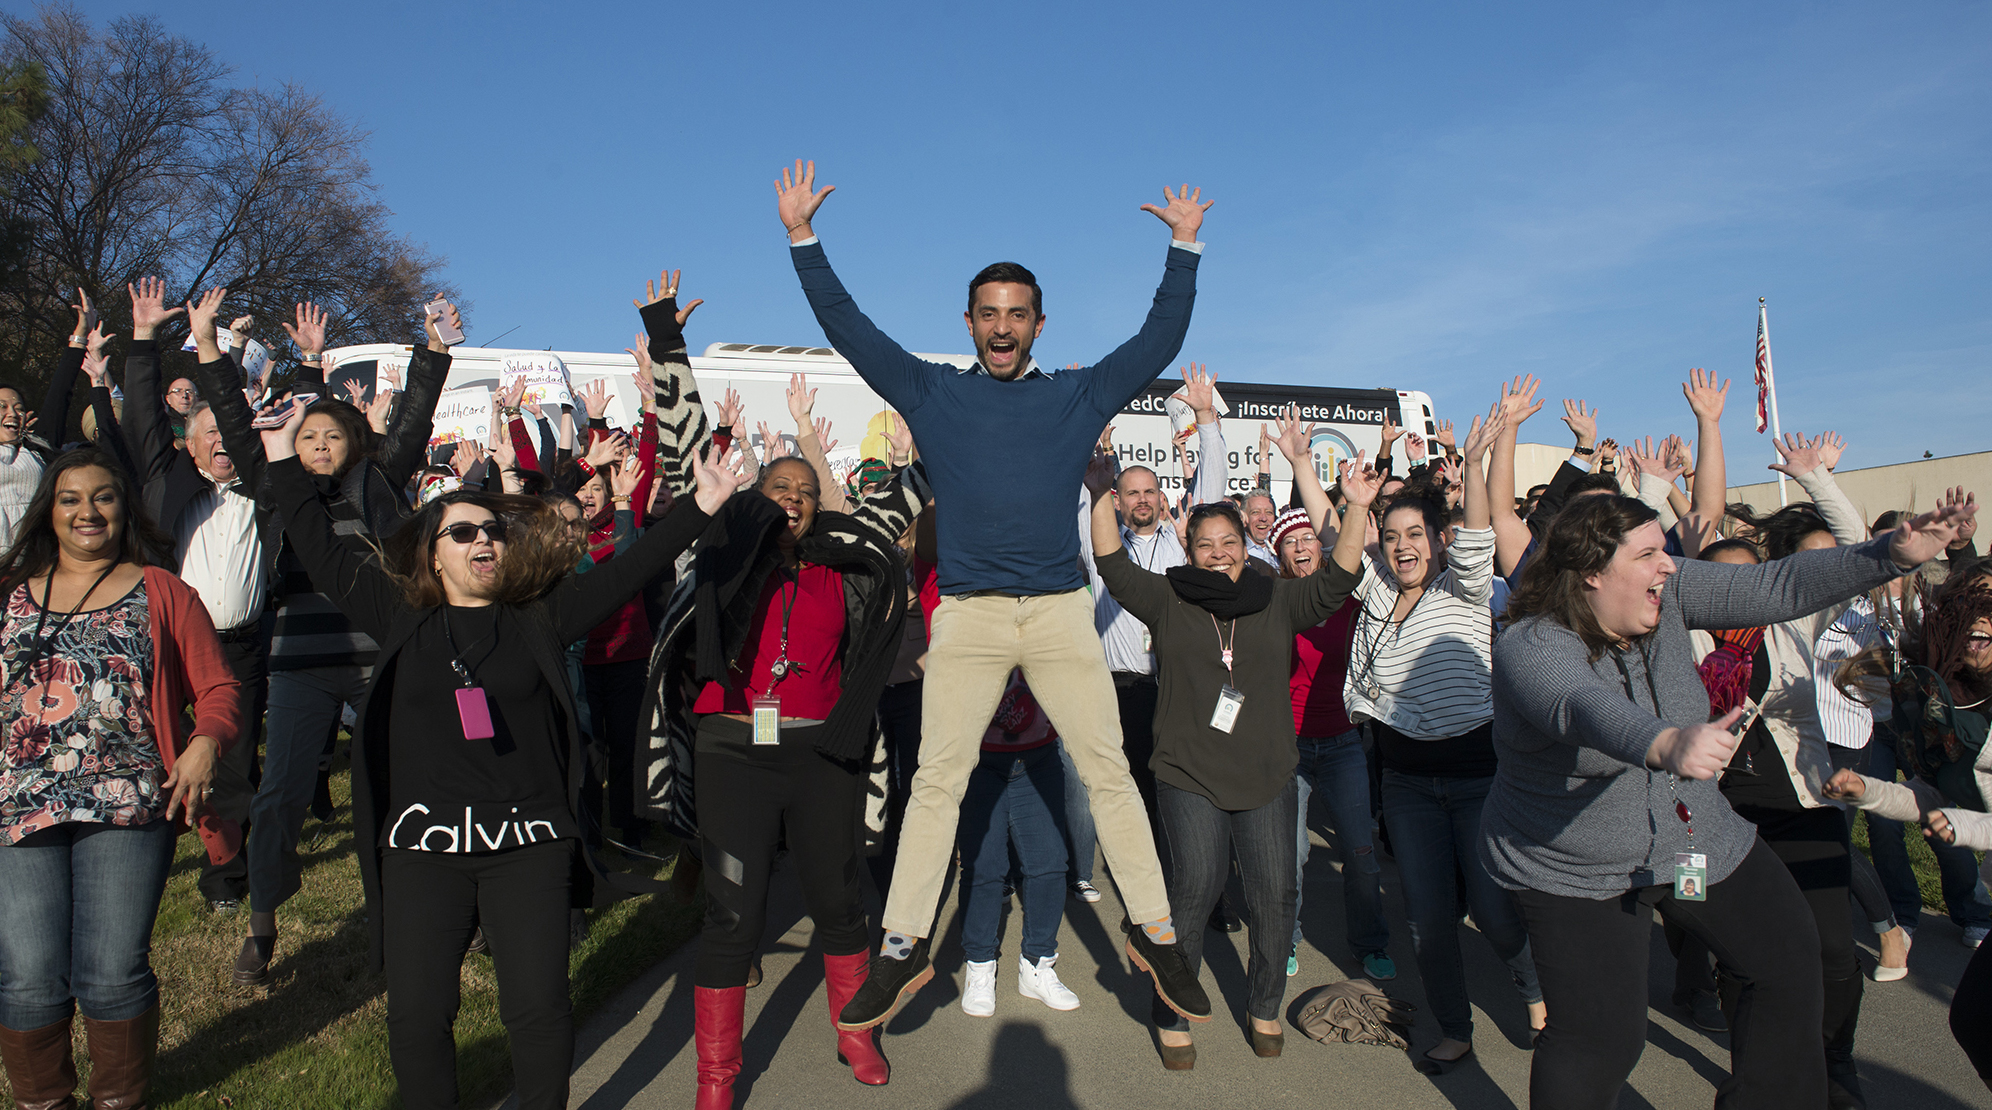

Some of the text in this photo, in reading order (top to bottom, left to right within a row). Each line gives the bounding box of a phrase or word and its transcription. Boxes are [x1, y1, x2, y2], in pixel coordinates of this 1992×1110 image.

[503, 359, 533, 374] Salud
[537, 364, 545, 374] y
[506, 374, 563, 388] Cmunidad
[1238, 401, 1329, 419] ¡Inscríbete
[1119, 442, 1167, 467] Help
[1173, 446, 1239, 469] Pag
[388, 802, 558, 853] Calvin
